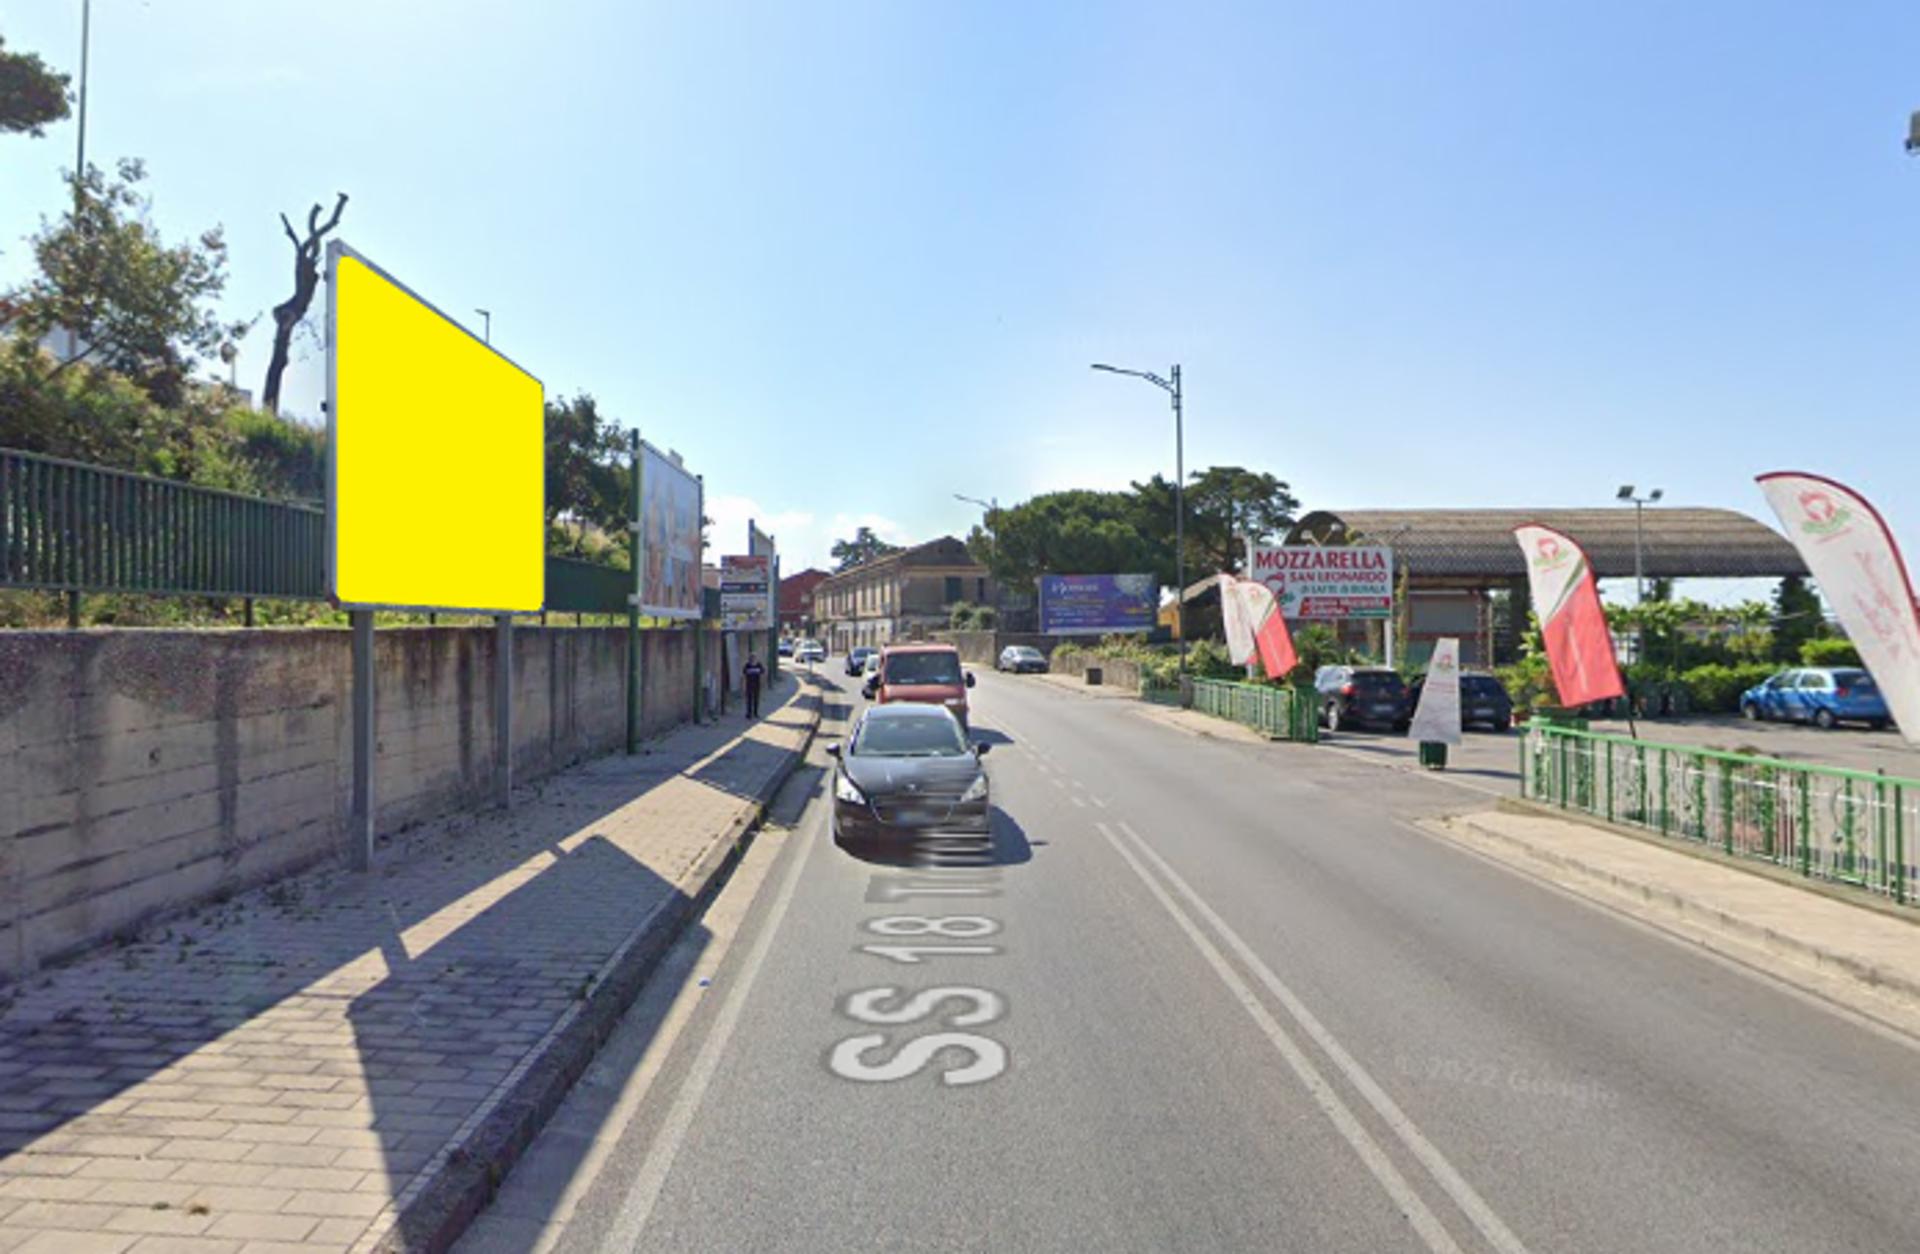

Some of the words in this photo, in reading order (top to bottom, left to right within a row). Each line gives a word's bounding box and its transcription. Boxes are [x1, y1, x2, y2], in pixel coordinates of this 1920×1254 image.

[1256, 550, 1386, 569] MOZZARELLA
[1290, 572, 1315, 583] SAN
[1318, 572, 1388, 583] LEONARDO
